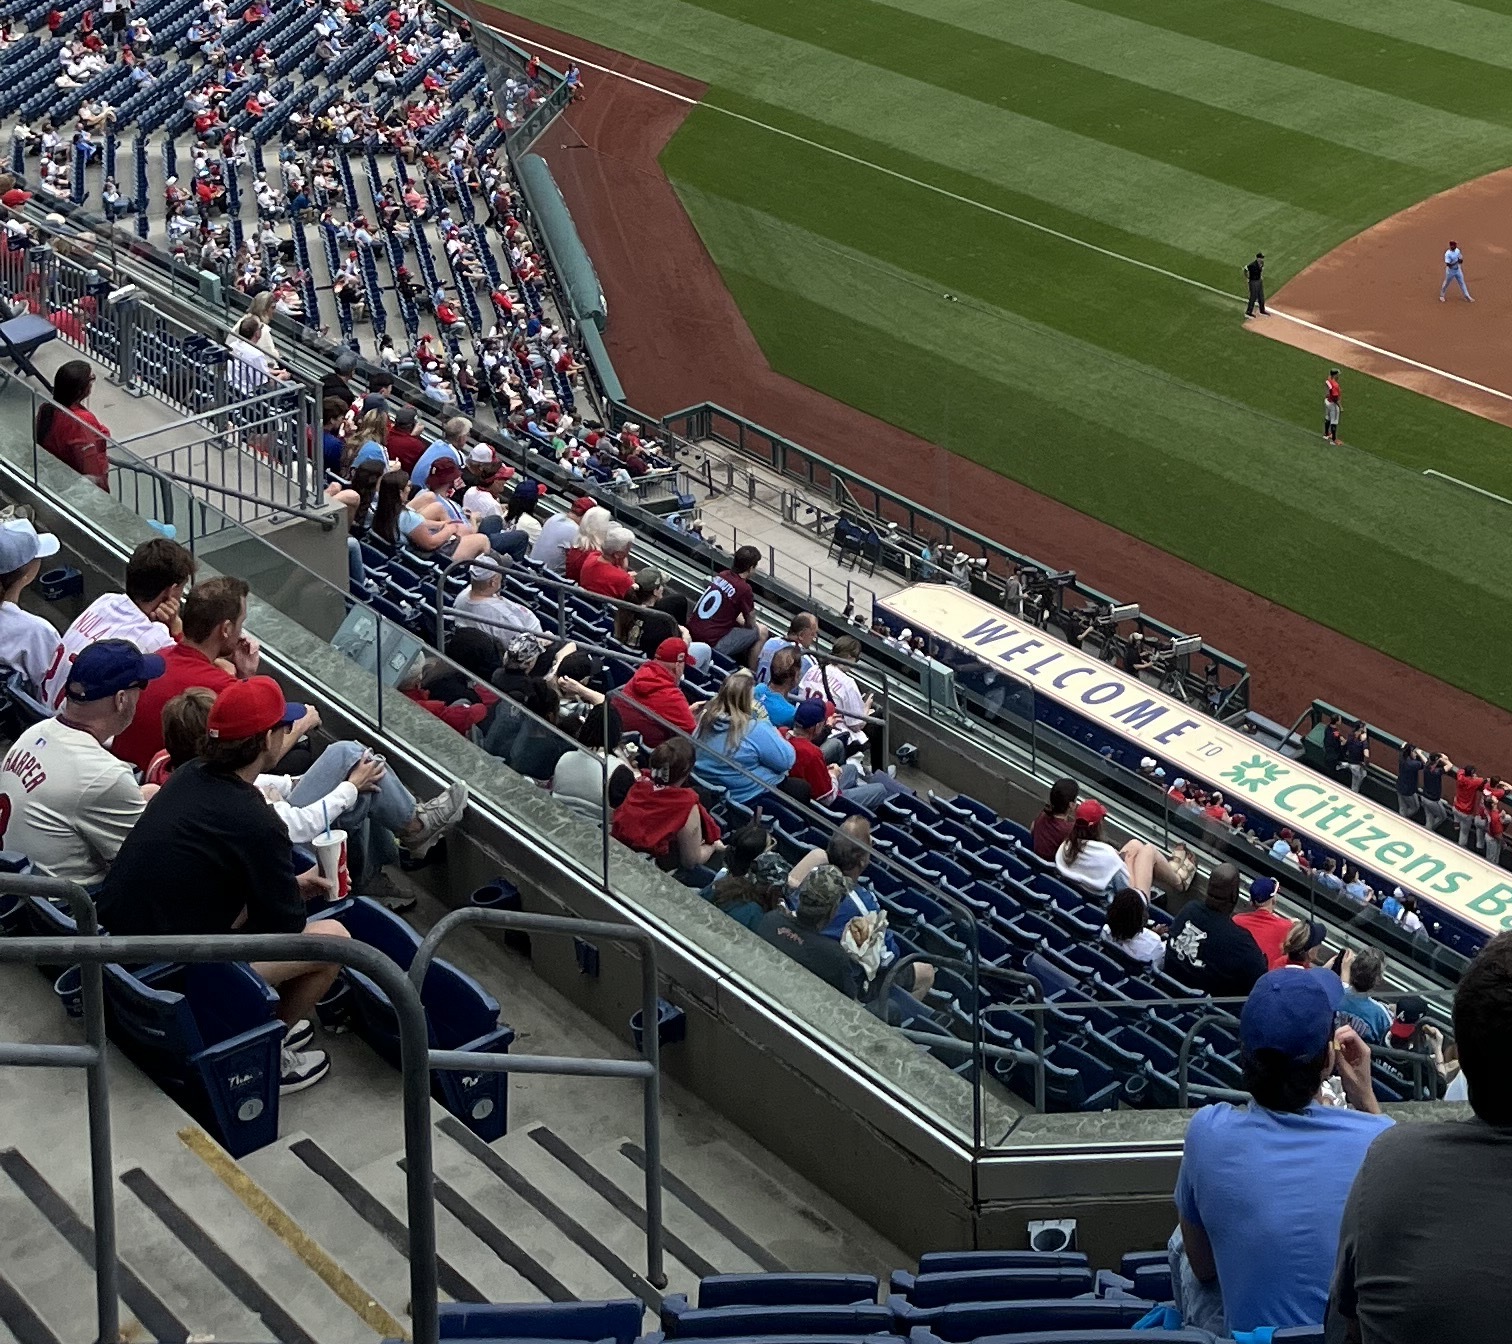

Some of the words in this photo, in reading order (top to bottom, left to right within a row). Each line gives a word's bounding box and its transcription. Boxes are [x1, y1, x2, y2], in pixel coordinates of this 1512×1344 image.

[76, 611, 111, 641] NOLA
[3, 749, 47, 794] HARPER
[962, 618, 1201, 745] WELCOME
[1197, 740, 1223, 757] TO
[1273, 782, 1473, 894] Citizens
